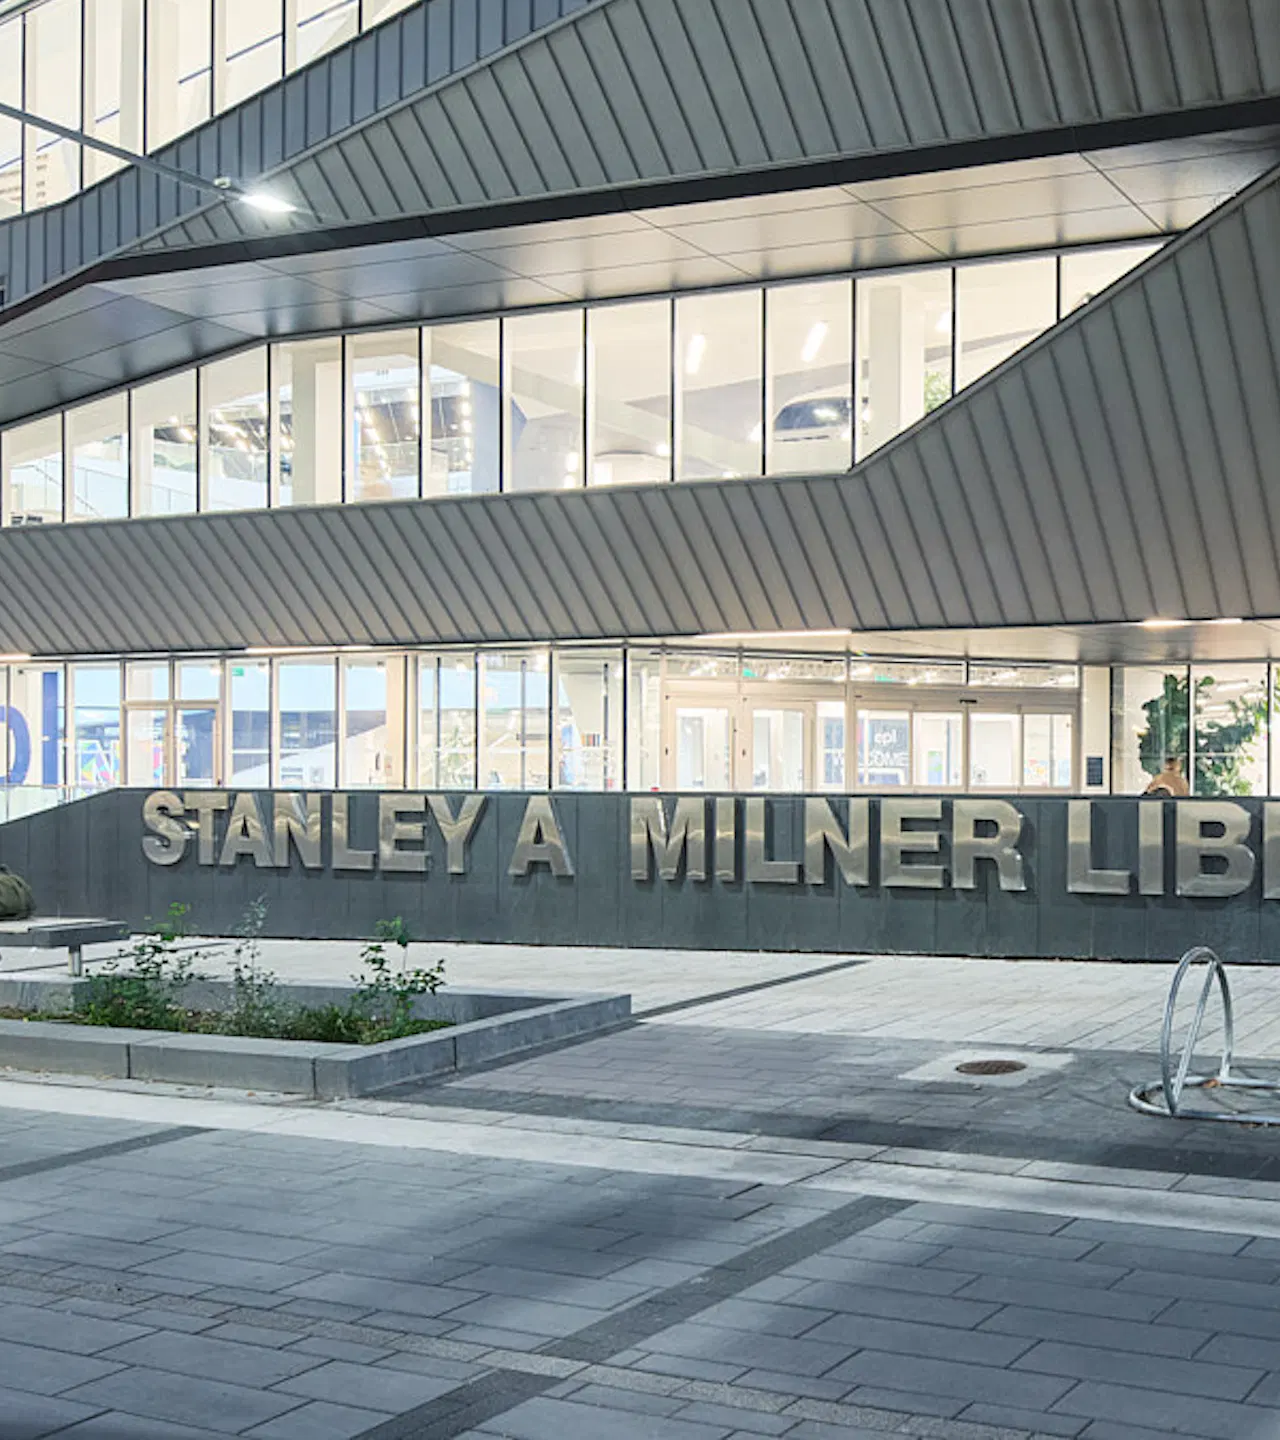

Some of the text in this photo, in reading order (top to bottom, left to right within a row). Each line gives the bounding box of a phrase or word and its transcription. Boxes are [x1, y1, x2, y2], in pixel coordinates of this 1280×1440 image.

[141, 790, 486, 874] STANLEY
[507, 796, 575, 877] A
[629, 796, 1026, 891] MILNER
